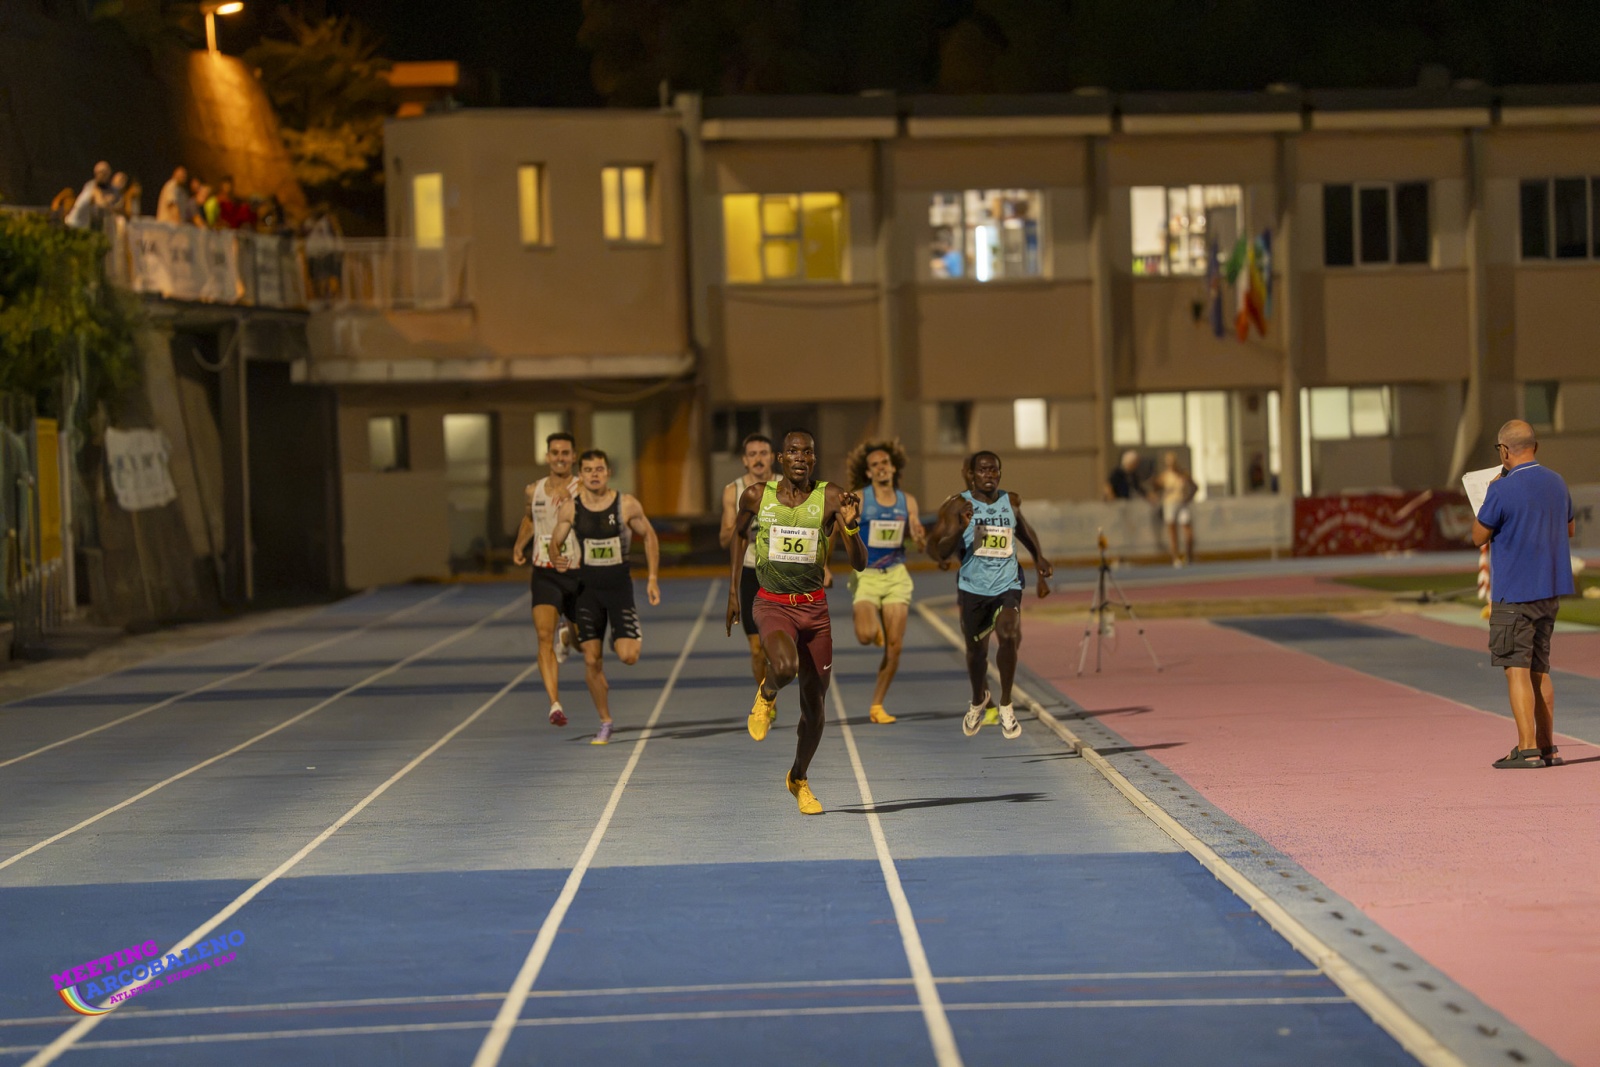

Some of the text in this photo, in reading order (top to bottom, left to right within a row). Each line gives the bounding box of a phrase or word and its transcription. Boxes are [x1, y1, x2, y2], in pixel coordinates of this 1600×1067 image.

[975, 515, 1010, 527] nerja
[881, 529, 895, 540] 17
[782, 537, 804, 553] 56
[982, 534, 1007, 549] 130
[591, 547, 614, 558] 171
